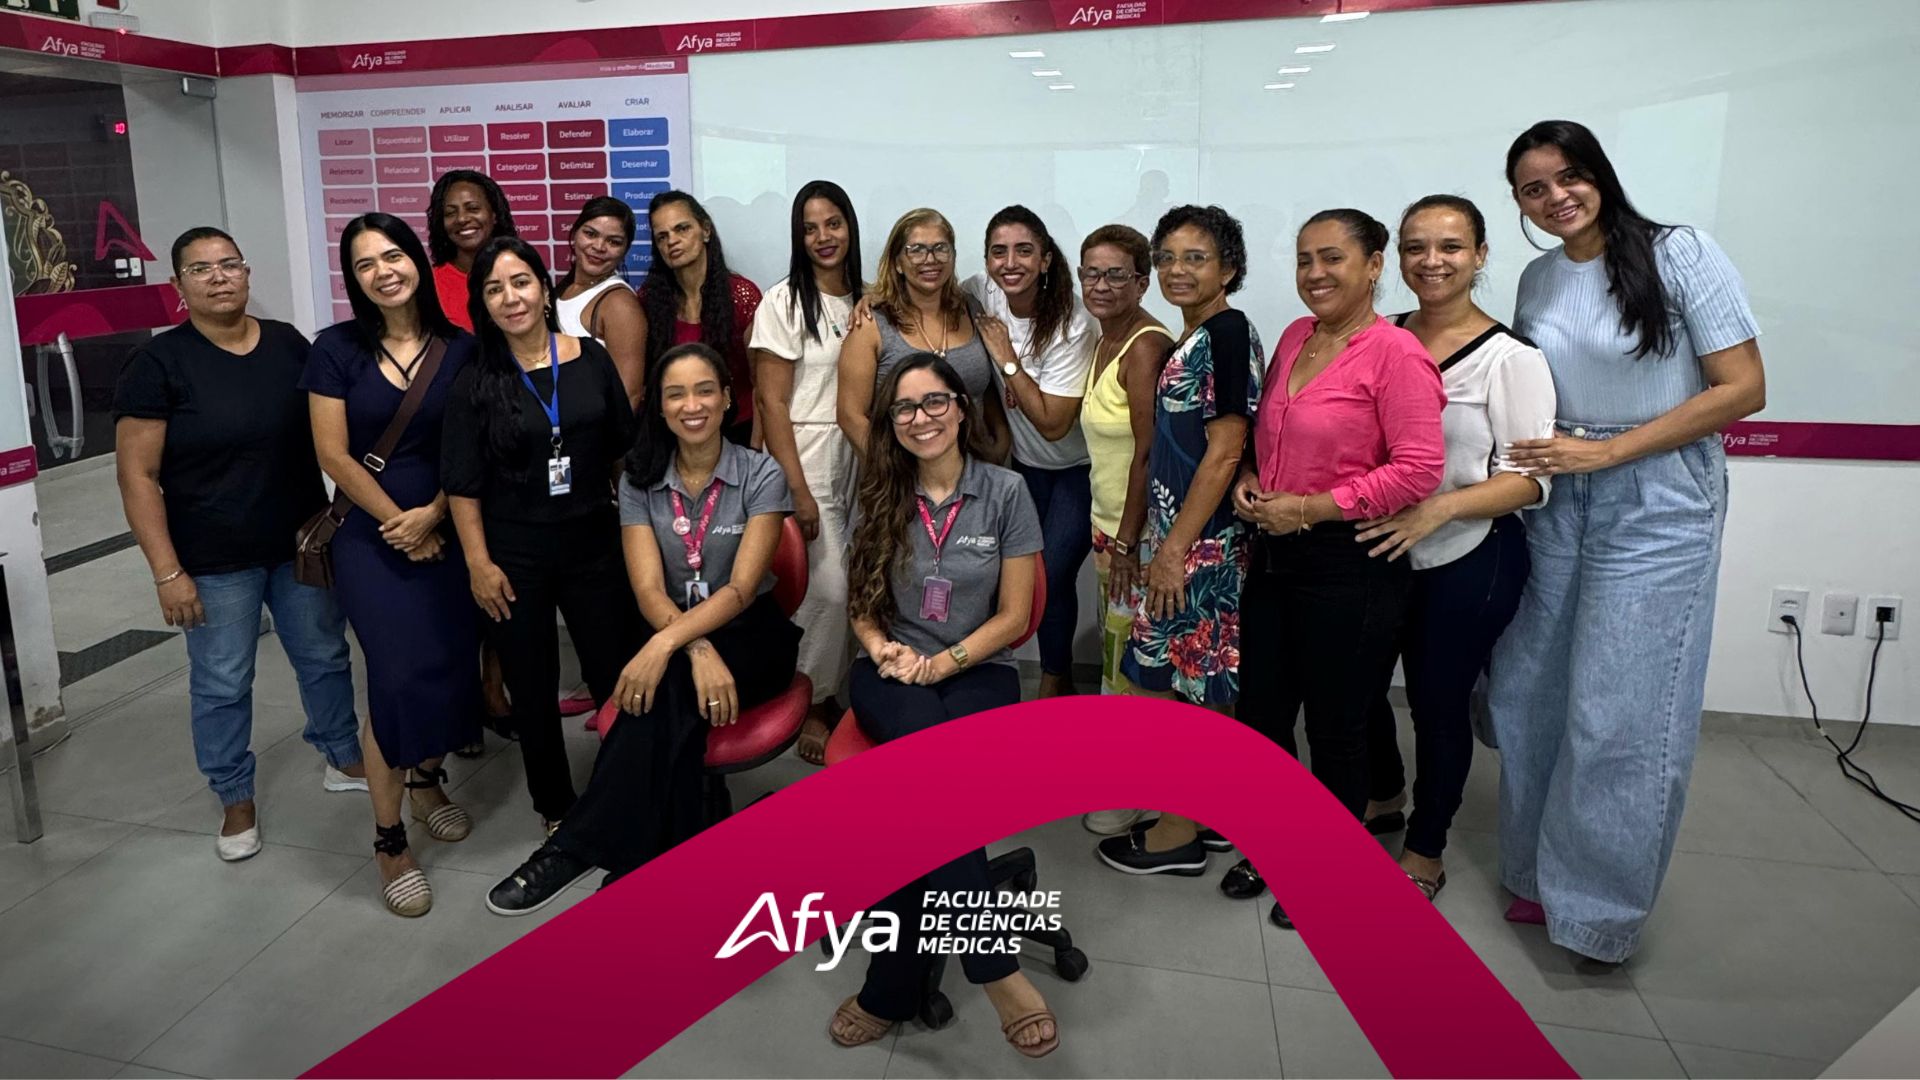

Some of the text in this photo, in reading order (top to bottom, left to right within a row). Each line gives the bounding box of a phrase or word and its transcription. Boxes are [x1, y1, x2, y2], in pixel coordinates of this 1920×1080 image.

[1069, 6, 1112, 26] Afya
[41, 36, 79, 56] Afya
[676, 34, 713, 52] Afya
[352, 53, 383, 70] Afya
[321, 98, 650, 119] MEMORIZAR COMPREENDER APLICAR ANALISAR AVALIAR CRIAR
[500, 132, 531, 140] Resolver
[559, 130, 592, 139] Defender
[623, 128, 654, 137] Elaborar
[496, 163, 538, 172] Categorizar
[560, 161, 595, 170] Delimitar
[622, 160, 658, 169] Desenhar
[384, 166, 420, 174] Relacionar
[564, 192, 594, 201] Estimar
[1723, 434, 1746, 448] fya
